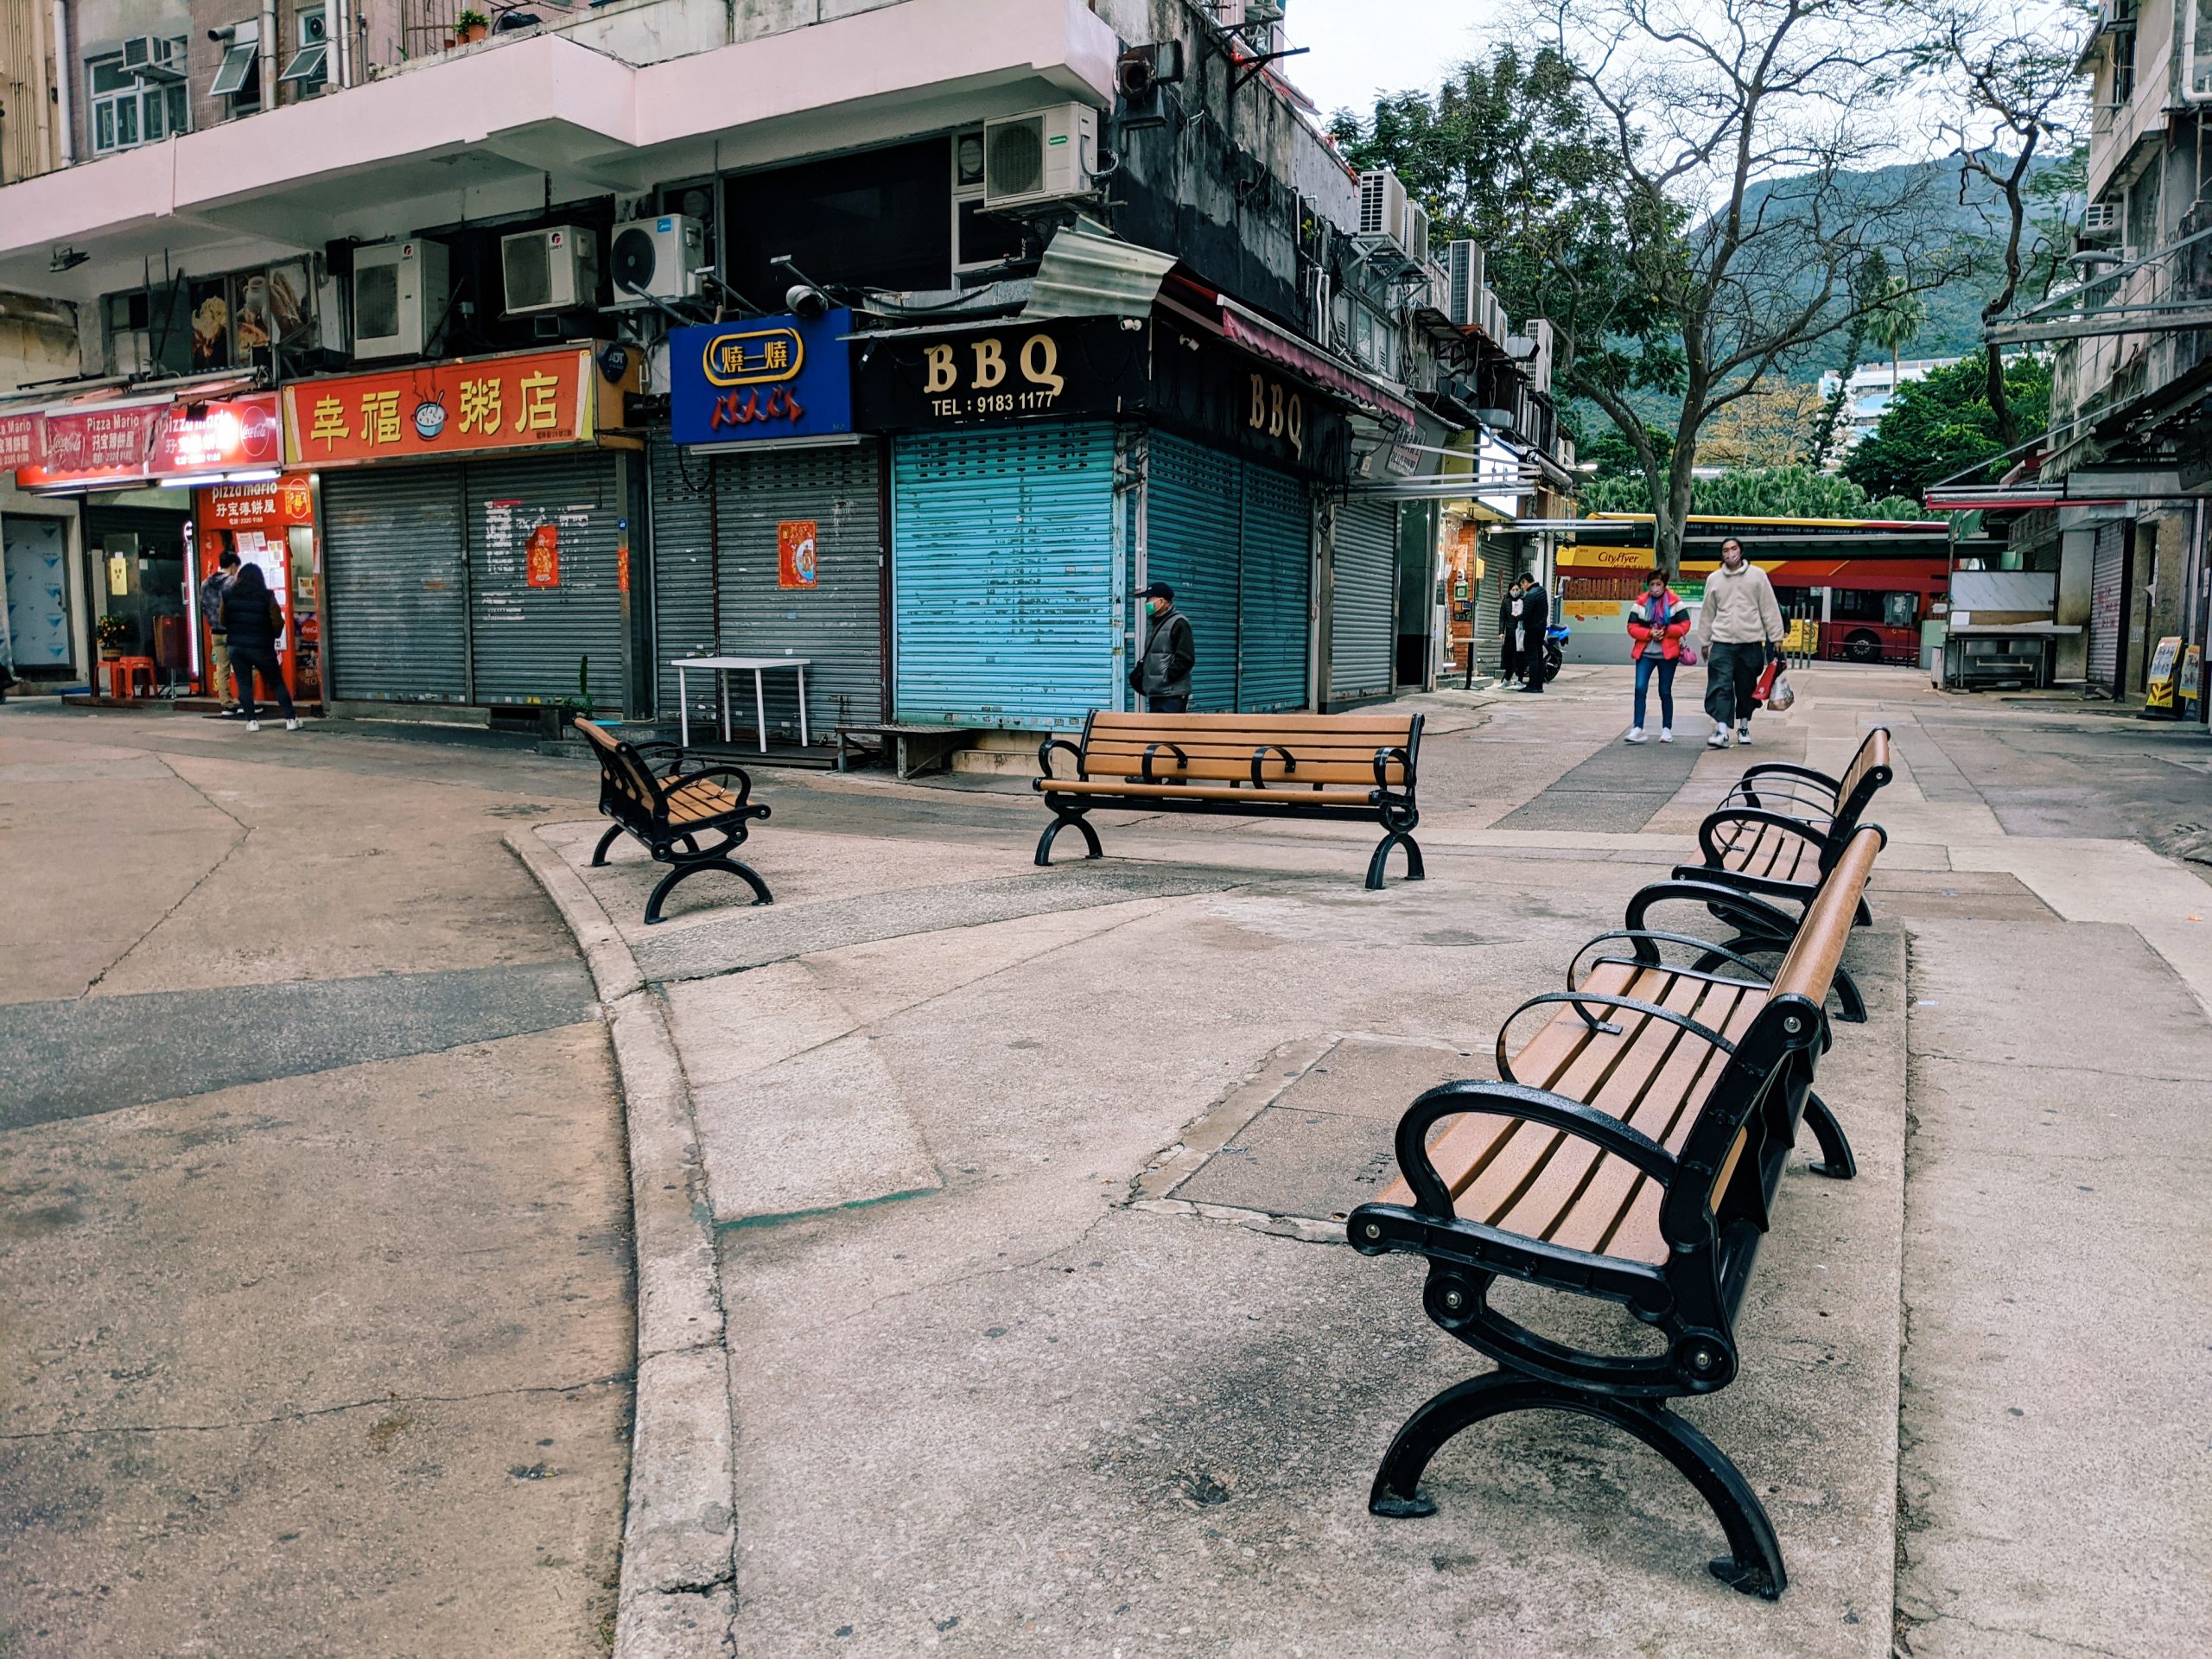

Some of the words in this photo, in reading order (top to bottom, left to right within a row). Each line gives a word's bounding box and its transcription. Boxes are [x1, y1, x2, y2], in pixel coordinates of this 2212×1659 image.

[608, 353, 624, 364] ADT
[924, 334, 1065, 397] BBQ
[977, 394, 1014, 413] 9183
[1019, 391, 1054, 410] 1177
[8, 419, 31, 432] Mario
[87, 417, 111, 431] Pizza
[113, 413, 139, 429] Mario
[1249, 373, 1302, 461] BBQ
[213, 486, 241, 503] pizza
[244, 482, 276, 496] mario
